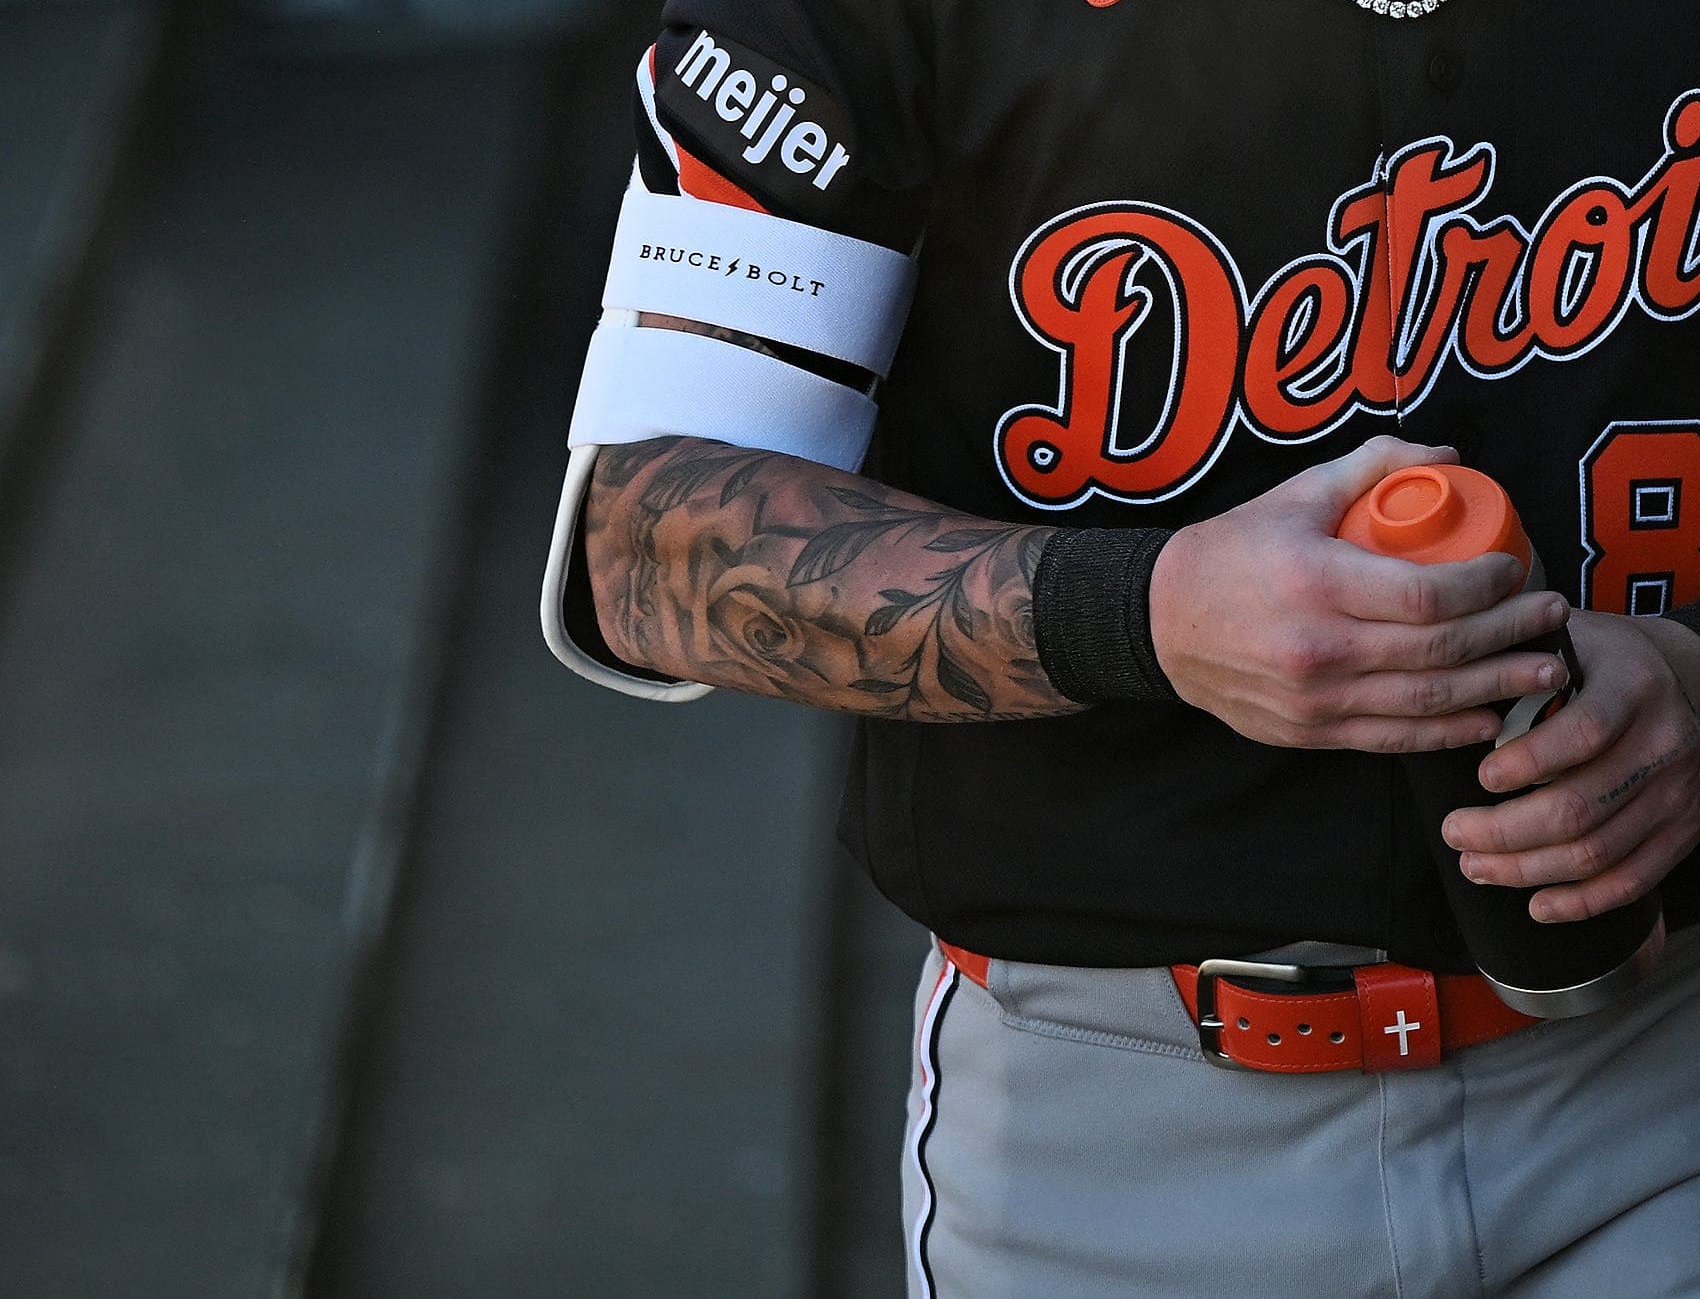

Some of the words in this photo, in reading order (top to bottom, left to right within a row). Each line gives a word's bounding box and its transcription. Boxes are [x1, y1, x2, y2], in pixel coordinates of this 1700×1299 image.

[675, 30, 850, 191] meijer
[640, 245, 720, 274] BRUCE
[748, 264, 825, 297] BOLT
